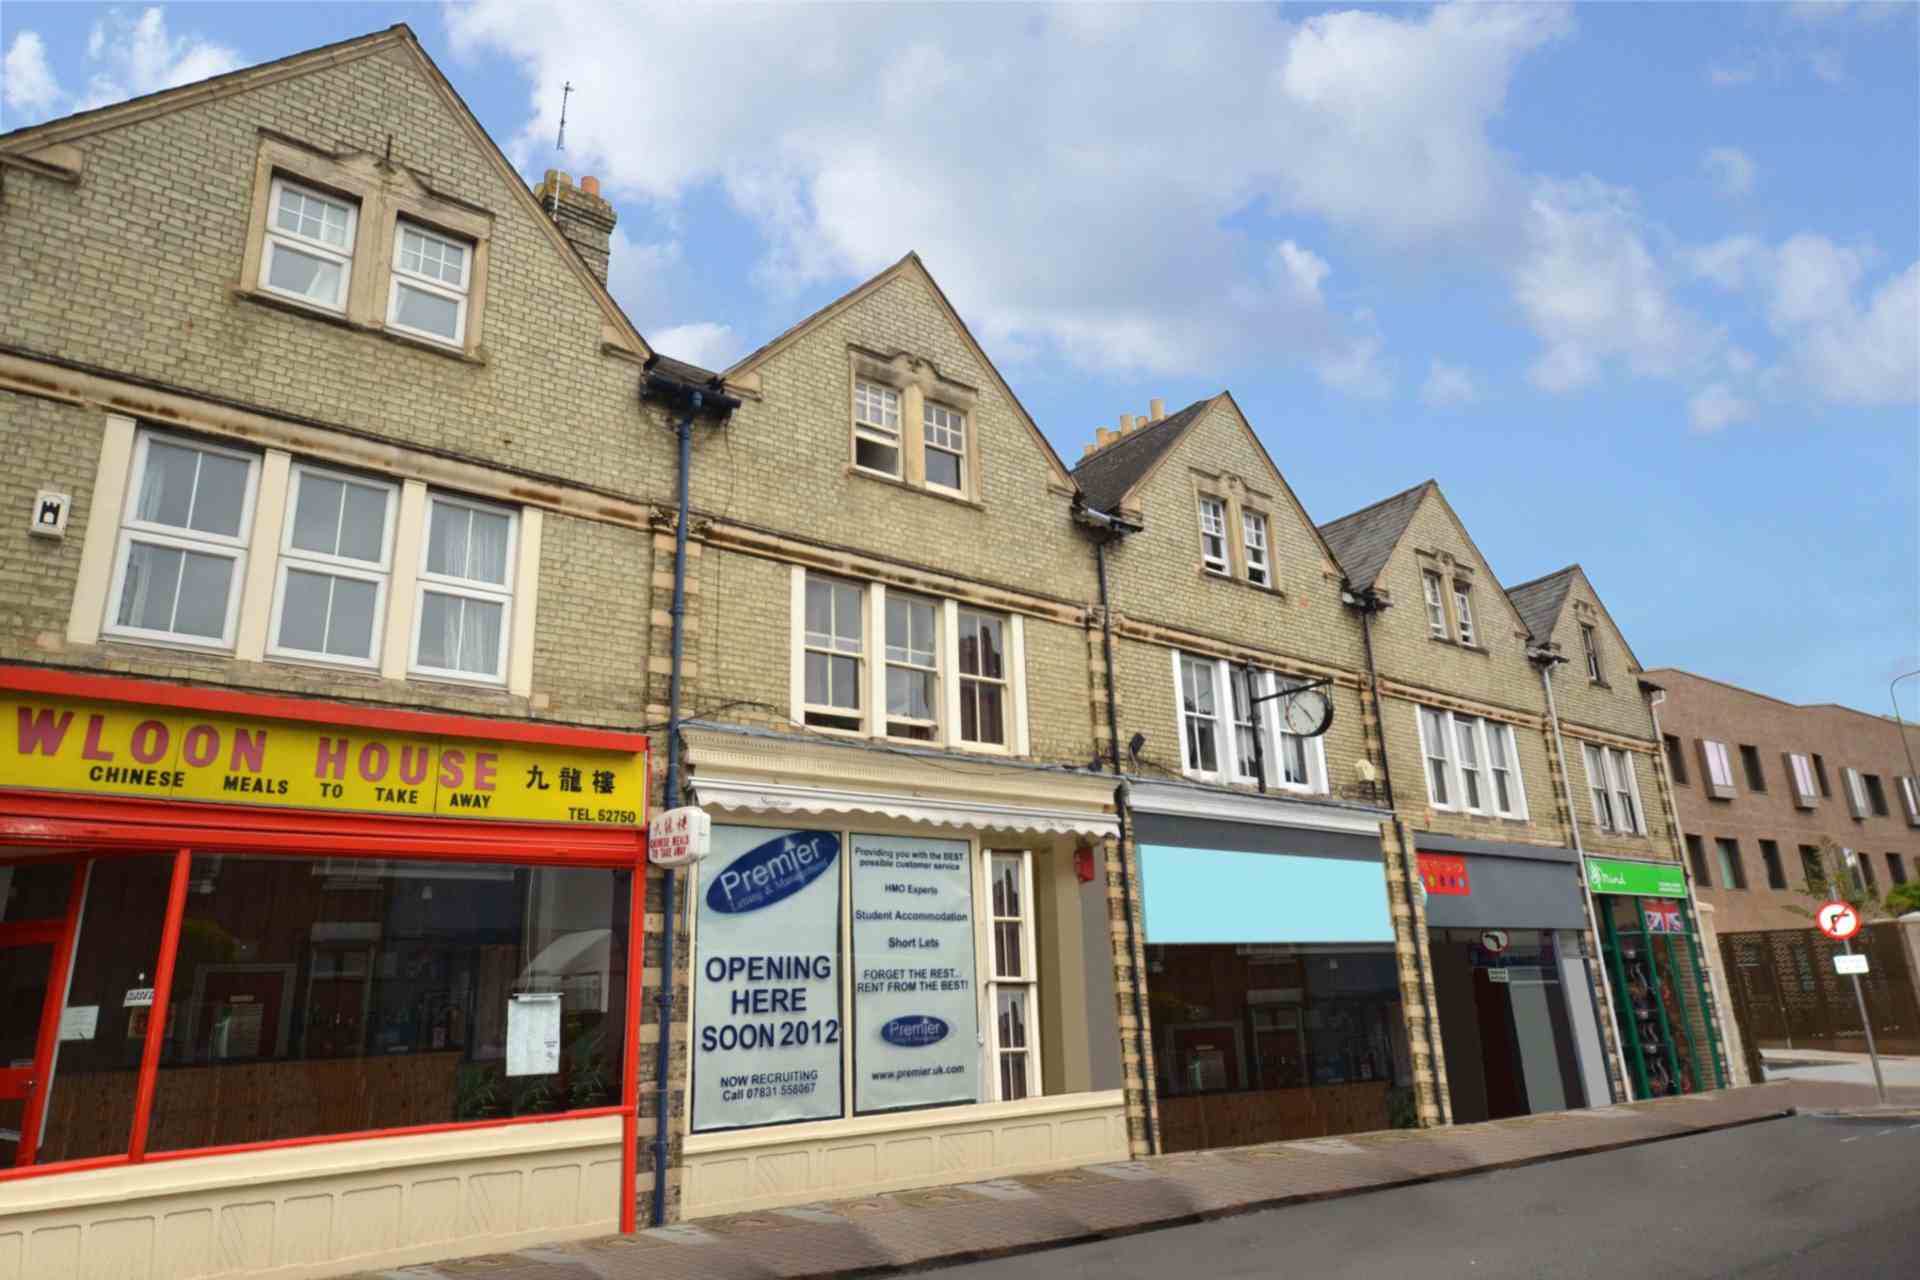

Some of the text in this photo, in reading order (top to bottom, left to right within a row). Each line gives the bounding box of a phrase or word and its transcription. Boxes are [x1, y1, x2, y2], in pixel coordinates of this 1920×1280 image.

[17, 705, 498, 791] WLOON HOUSE
[89, 766, 491, 808] CHINESE MEALS TO TAKE AWAY
[854, 846, 963, 861] Providing you with the BEST
[720, 837, 820, 901] Premier
[859, 860, 960, 871] possible customer service
[884, 883, 938, 896] HMO Experts
[855, 910, 968, 922] Student Accommodation
[888, 937, 939, 948] Short Lets
[705, 955, 832, 982] OPENING
[863, 968, 905, 980] FORGET
[909, 968, 928, 979] THE
[857, 979, 969, 993] RENT FROM THE BEST!
[731, 987, 807, 1014] HERE
[701, 1018, 839, 1052] SOON 2012
[889, 1017, 940, 1037] Premier
[720, 1069, 819, 1088] NOW RECRUITING
[722, 1089, 744, 1102] Call
